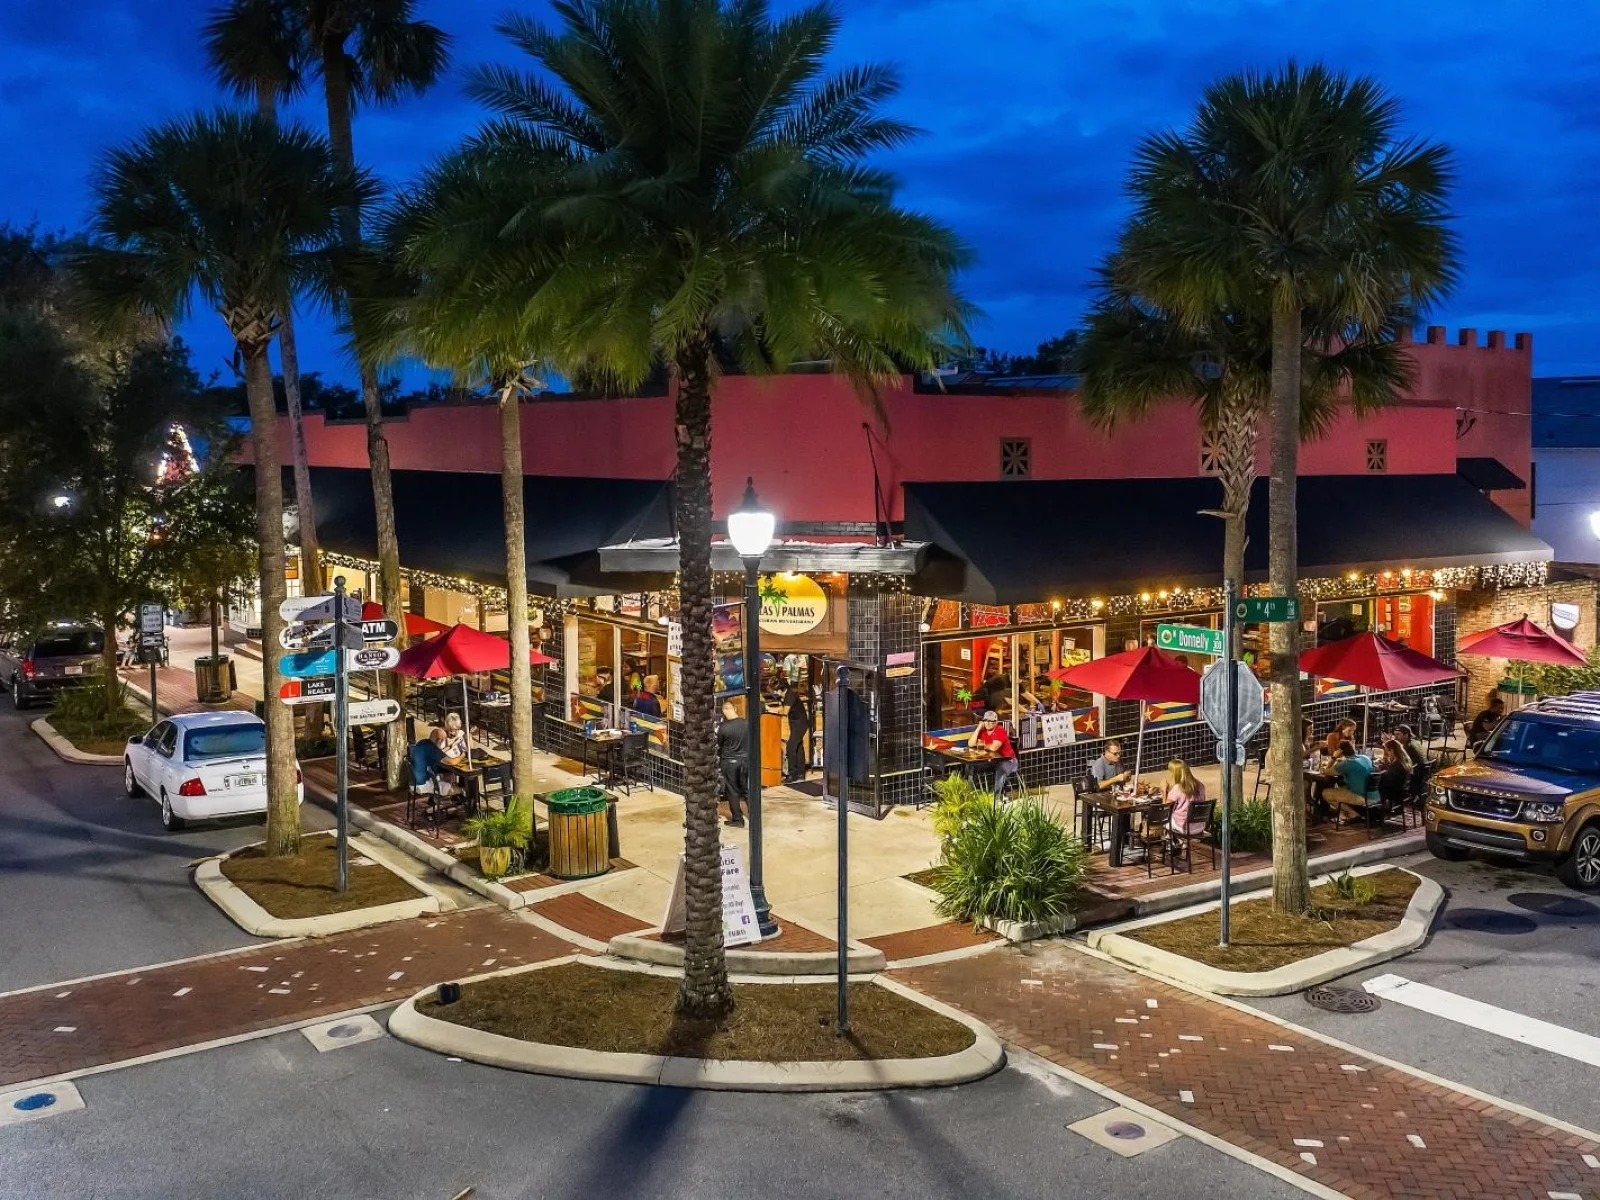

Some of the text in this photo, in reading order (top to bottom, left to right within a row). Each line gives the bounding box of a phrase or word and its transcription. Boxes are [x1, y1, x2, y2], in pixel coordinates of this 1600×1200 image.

[759, 606, 815, 617] LAS PALMAS
[361, 622, 386, 634] ATM
[1179, 630, 1210, 652] Donnelly
[307, 681, 325, 689] LAKE
[307, 687, 333, 696] REALTY
